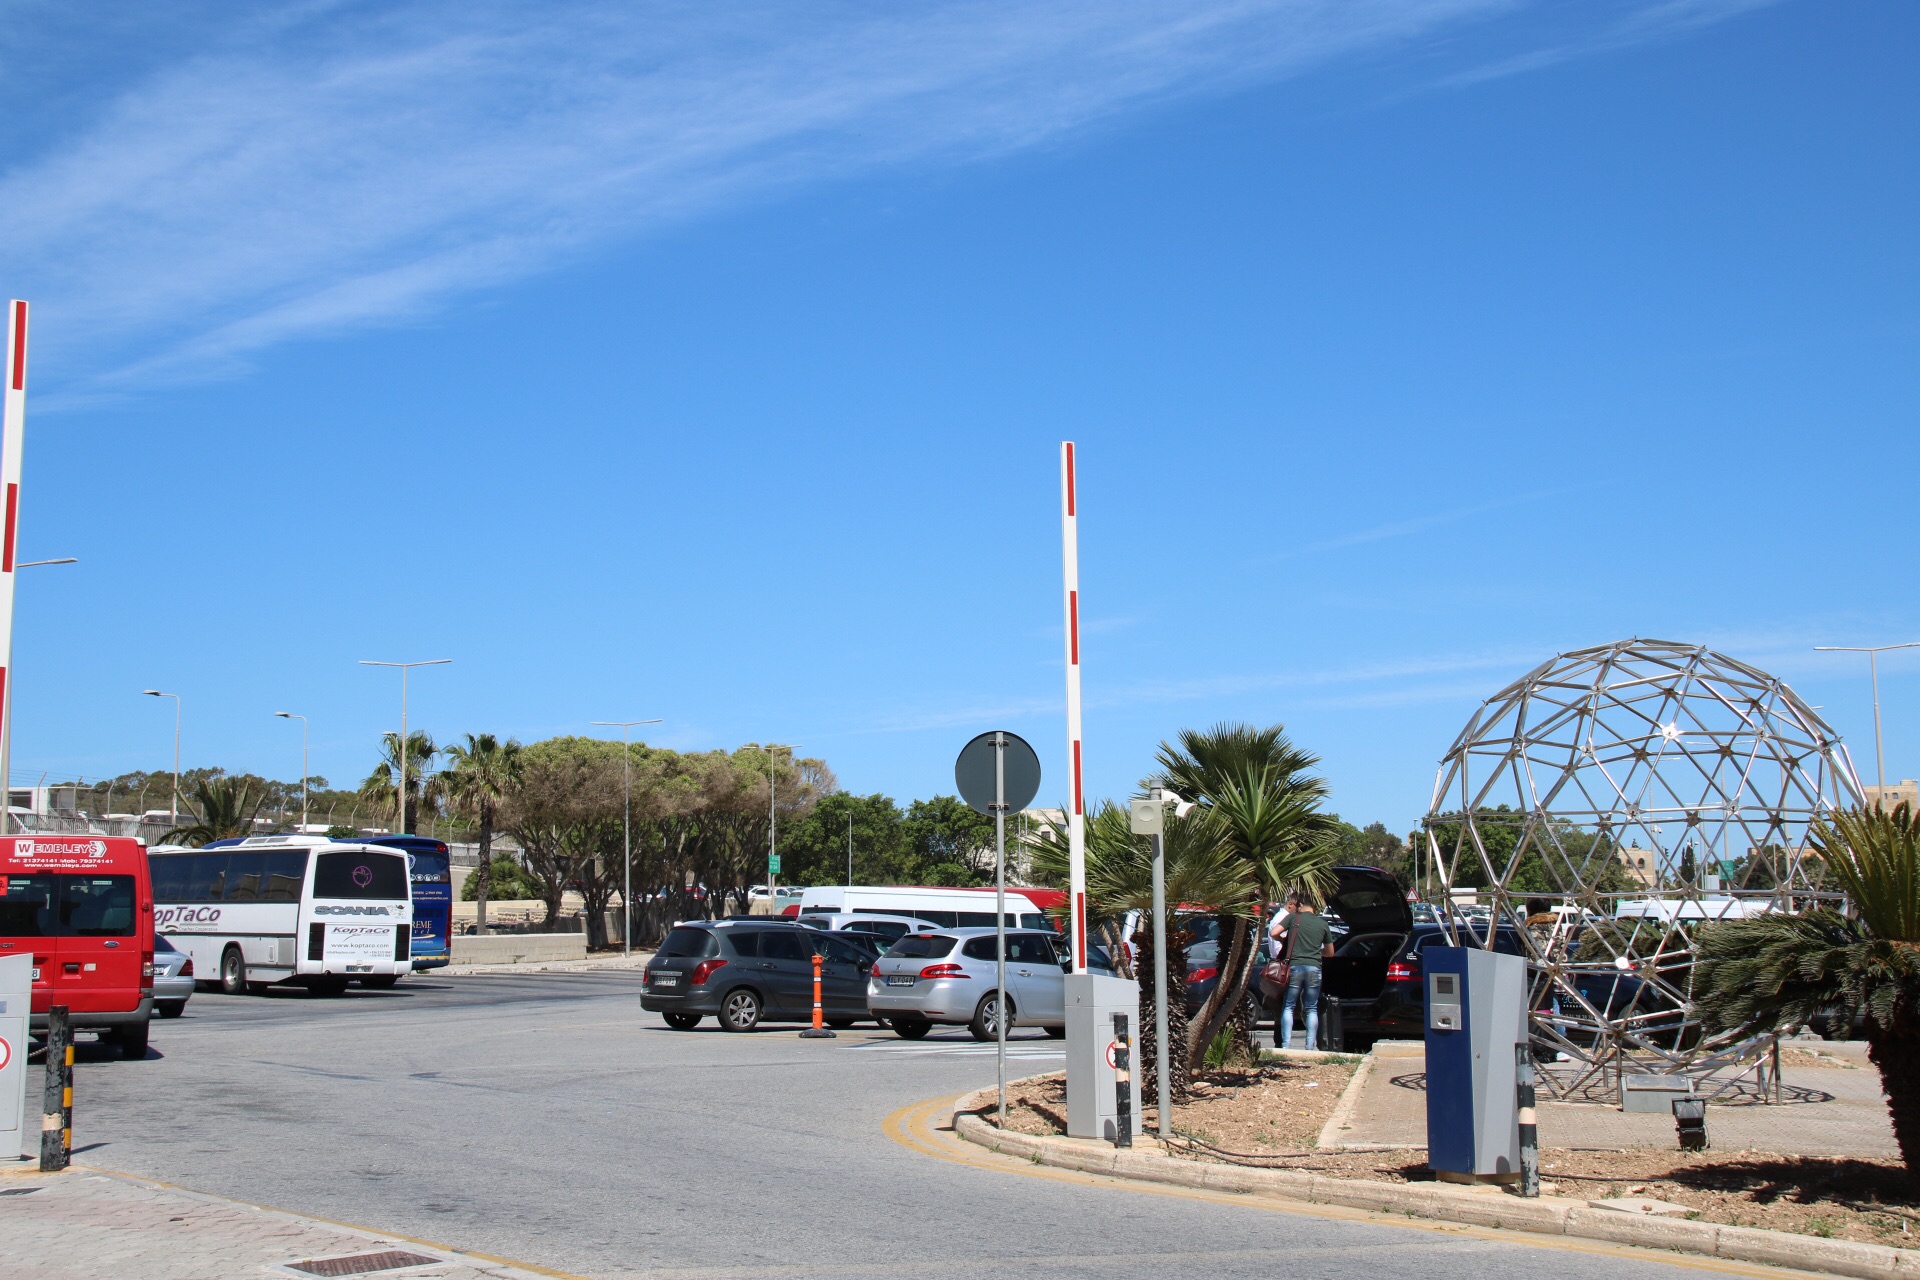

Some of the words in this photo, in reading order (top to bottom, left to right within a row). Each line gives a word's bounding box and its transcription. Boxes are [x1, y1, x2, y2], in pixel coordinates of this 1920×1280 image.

[16, 842, 99, 854] WEMBLEYS
[154, 906, 221, 925] opTaCo
[314, 905, 390, 916] SCANIA
[332, 926, 390, 934] KopTaCo
